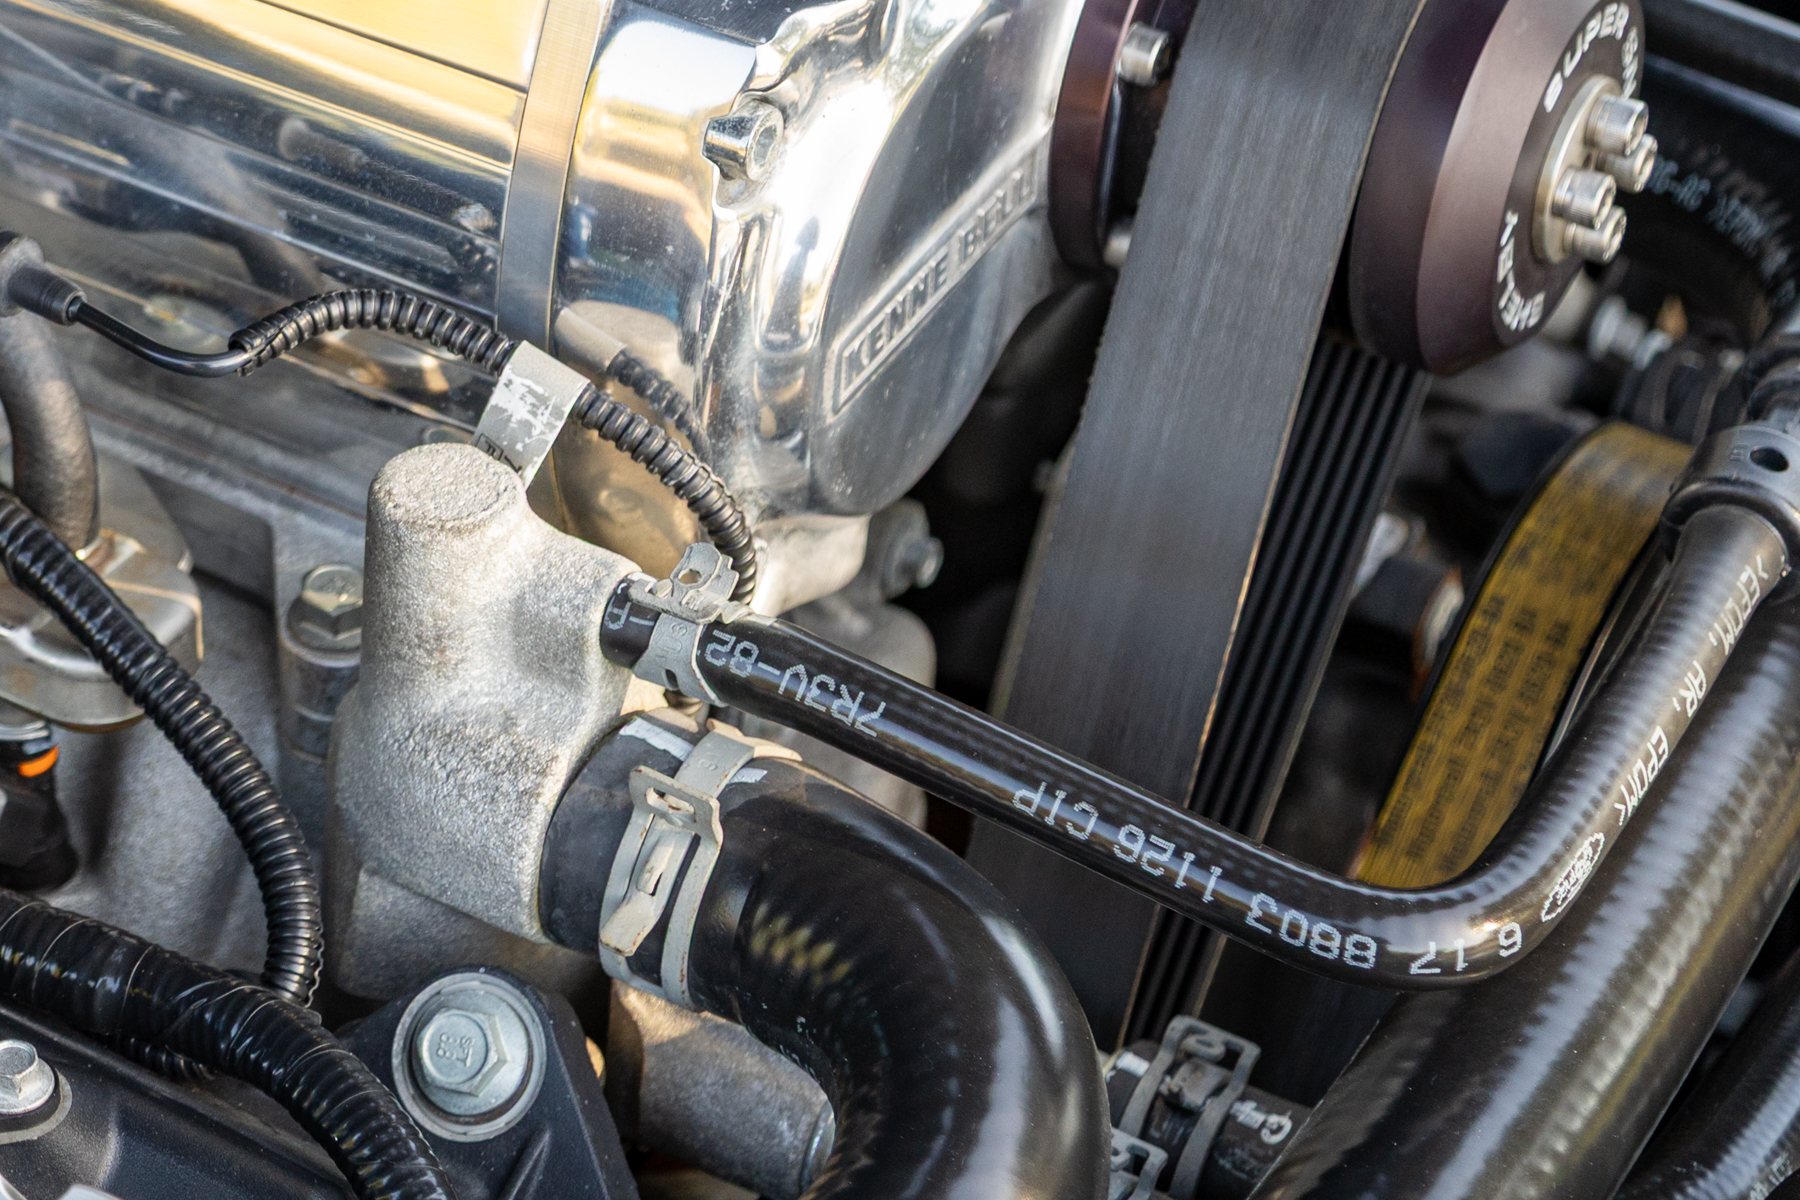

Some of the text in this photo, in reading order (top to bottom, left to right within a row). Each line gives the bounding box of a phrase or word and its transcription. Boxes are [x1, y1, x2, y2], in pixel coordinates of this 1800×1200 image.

[1543, 2, 1630, 113] SUPER
[840, 169, 1032, 390] KENNE BELL
[1112, 823, 1223, 904] 1126
[1245, 892, 1378, 970] 8803
[1409, 938, 1469, 975] 17
[1498, 921, 1523, 958] 6
